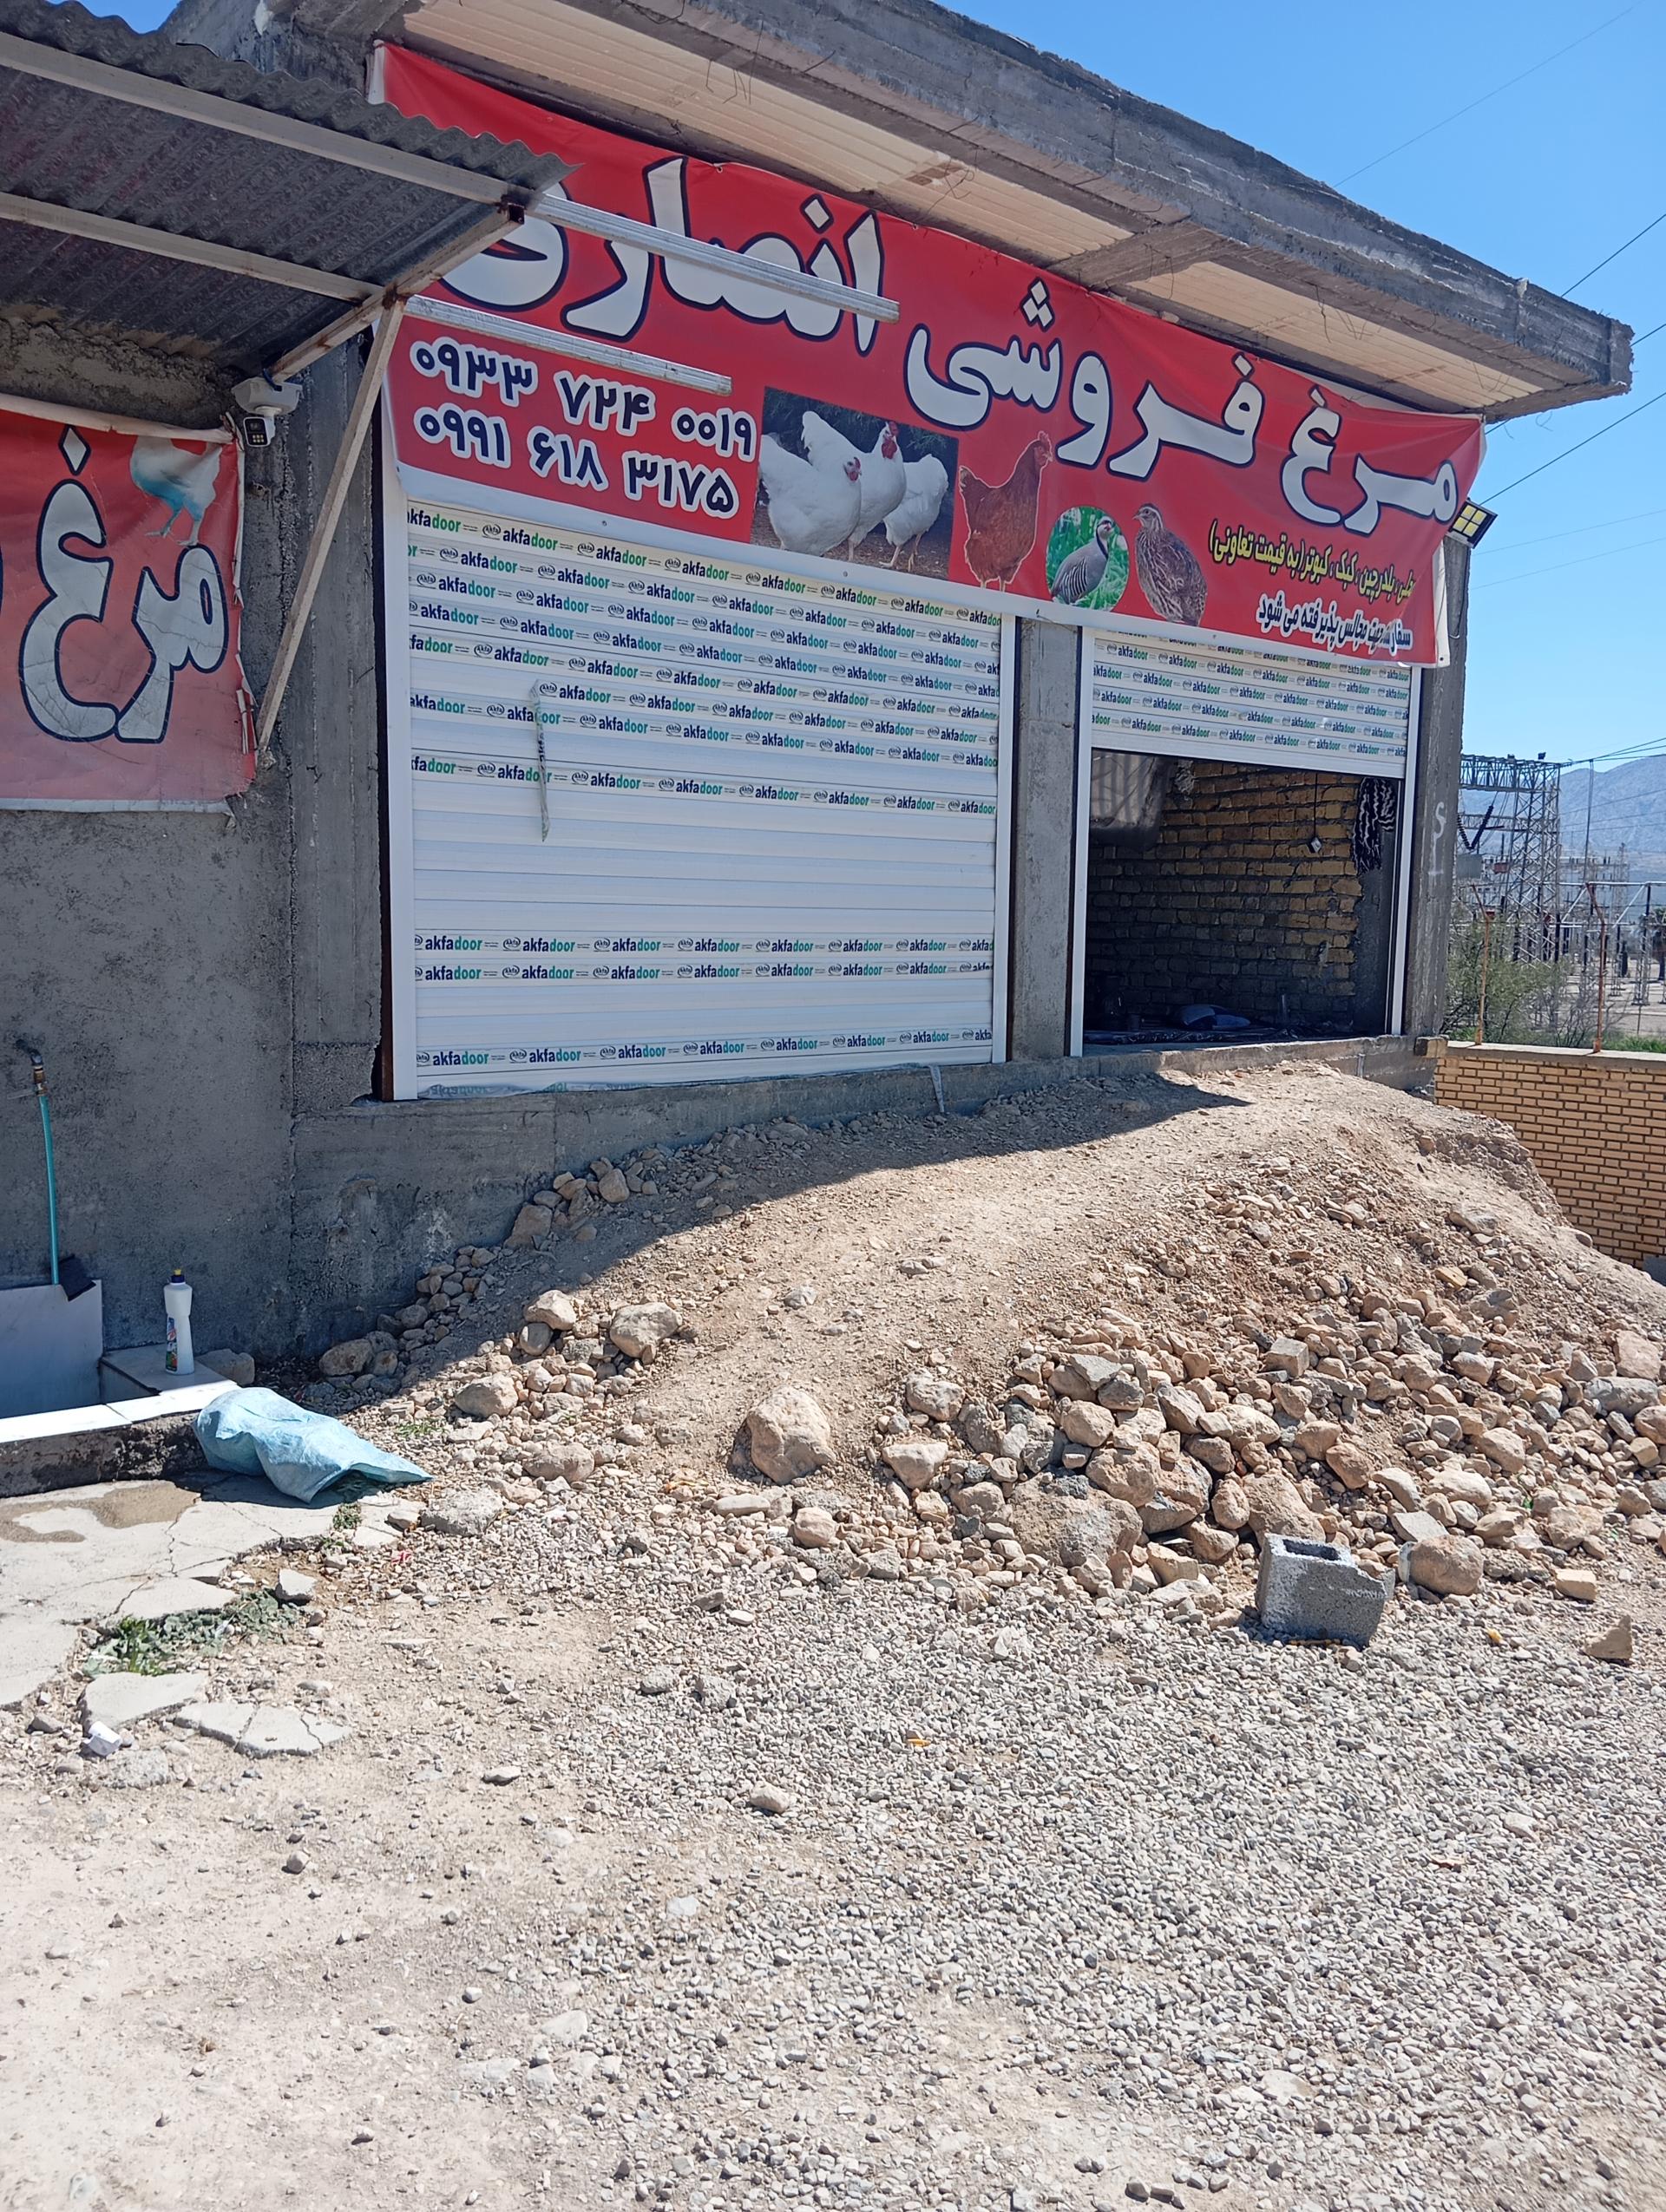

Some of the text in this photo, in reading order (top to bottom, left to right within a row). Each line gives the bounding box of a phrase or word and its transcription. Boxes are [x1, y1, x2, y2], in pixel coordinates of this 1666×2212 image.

[436, 156, 1459, 535] مرغ فروشی انصاری
[412, 338, 753, 460] ۰۹۳۳ ۷۲۴ ۰۰۱۹
[416, 405, 738, 516] ۰۹۹۱ ۶۱۸ ۳۱۷۵
[1209, 518, 1255, 565] تعاونی)
[1255, 531, 1288, 574] قیمت
[18, 424, 228, 743] مرغ
[461, 552, 517, 573] akfadoor
[558, 569, 609, 589] akfadoor
[646, 584, 694, 603] akfadoor
[729, 598, 773, 616] akfadoor
[806, 610, 846, 628] akfadoor
[876, 622, 915, 638] akfadoor
[942, 632, 978, 648] akfadoor
[503, 528, 558, 551] akfadoor
[596, 546, 646, 567] akfadoor
[682, 560, 729, 581] akfadoor
[762, 574, 805, 593] akfadoor
[836, 586, 876, 606] akfadoor
[905, 599, 943, 617] akfadoor
[439, 577, 495, 599] akfadoor
[536, 593, 588, 613] akfadoor
[626, 608, 674, 626] akfadoor
[710, 620, 754, 638] akfadoor
[786, 632, 828, 649] akfadoor
[858, 643, 897, 659] akfadoor
[925, 652, 961, 668] akfadoor
[1258, 592, 1283, 629] شود
[1282, 607, 1300, 634] می
[421, 605, 479, 625] akfadoor
[521, 620, 574, 639] akfadoor
[613, 633, 661, 651] akfadoor
[696, 645, 742, 664] akfadoor
[775, 657, 817, 672] akfadoor
[848, 666, 886, 683] akfadoor
[915, 676, 952, 690] akfadoor
[495, 647, 548, 666] akfadoor
[587, 660, 638, 677] akfadoor
[674, 671, 720, 689] akfadoor
[754, 682, 797, 697] akfadoor
[828, 690, 869, 707] akfadoor
[897, 699, 935, 714] akfadoor
[559, 685, 611, 703] akfadoor
[647, 697, 695, 712] akfadoor
[729, 706, 773, 722] akfadoor
[805, 713, 846, 730] akfadoor
[875, 721, 914, 736] akfadoor
[941, 729, 977, 744] akfadoor
[599, 717, 648, 734] akfadoor
[683, 725, 729, 742] akfadoor
[762, 733, 803, 749] akfadoor
[835, 740, 874, 756] akfadoor
[902, 748, 939, 762] akfadoor
[591, 773, 640, 789] akfadoor
[676, 780, 723, 796] akfadoor
[756, 786, 798, 801] akfadoor
[829, 791, 869, 806] akfadoor
[897, 796, 935, 810] akfadoor
[961, 801, 995, 814] akfadoor
[425, 936, 482, 951] akfadoor
[523, 938, 575, 952] akfadoor
[613, 939, 660, 952] akfadoor
[694, 938, 739, 952] akfadoor
[771, 939, 813, 952] akfadoor
[843, 939, 882, 952] akfadoor
[909, 939, 947, 952] akfadoor
[425, 965, 481, 980] akfadoor
[521, 965, 574, 979] akfadoor
[611, 965, 659, 979] akfadoor
[694, 964, 739, 978] akfadoor
[771, 964, 813, 977] akfadoor
[843, 963, 882, 976] akfadoor
[910, 962, 947, 975] akfadoor
[433, 1051, 489, 1065] akfadoor
[529, 1049, 581, 1063] akfadoor
[619, 1045, 666, 1059] akfadoor
[699, 1041, 744, 1054] akfadoor
[777, 1038, 817, 1050] akfadoor
[847, 1035, 885, 1047] akfadoor
[913, 1031, 949, 1043] akfadoor
